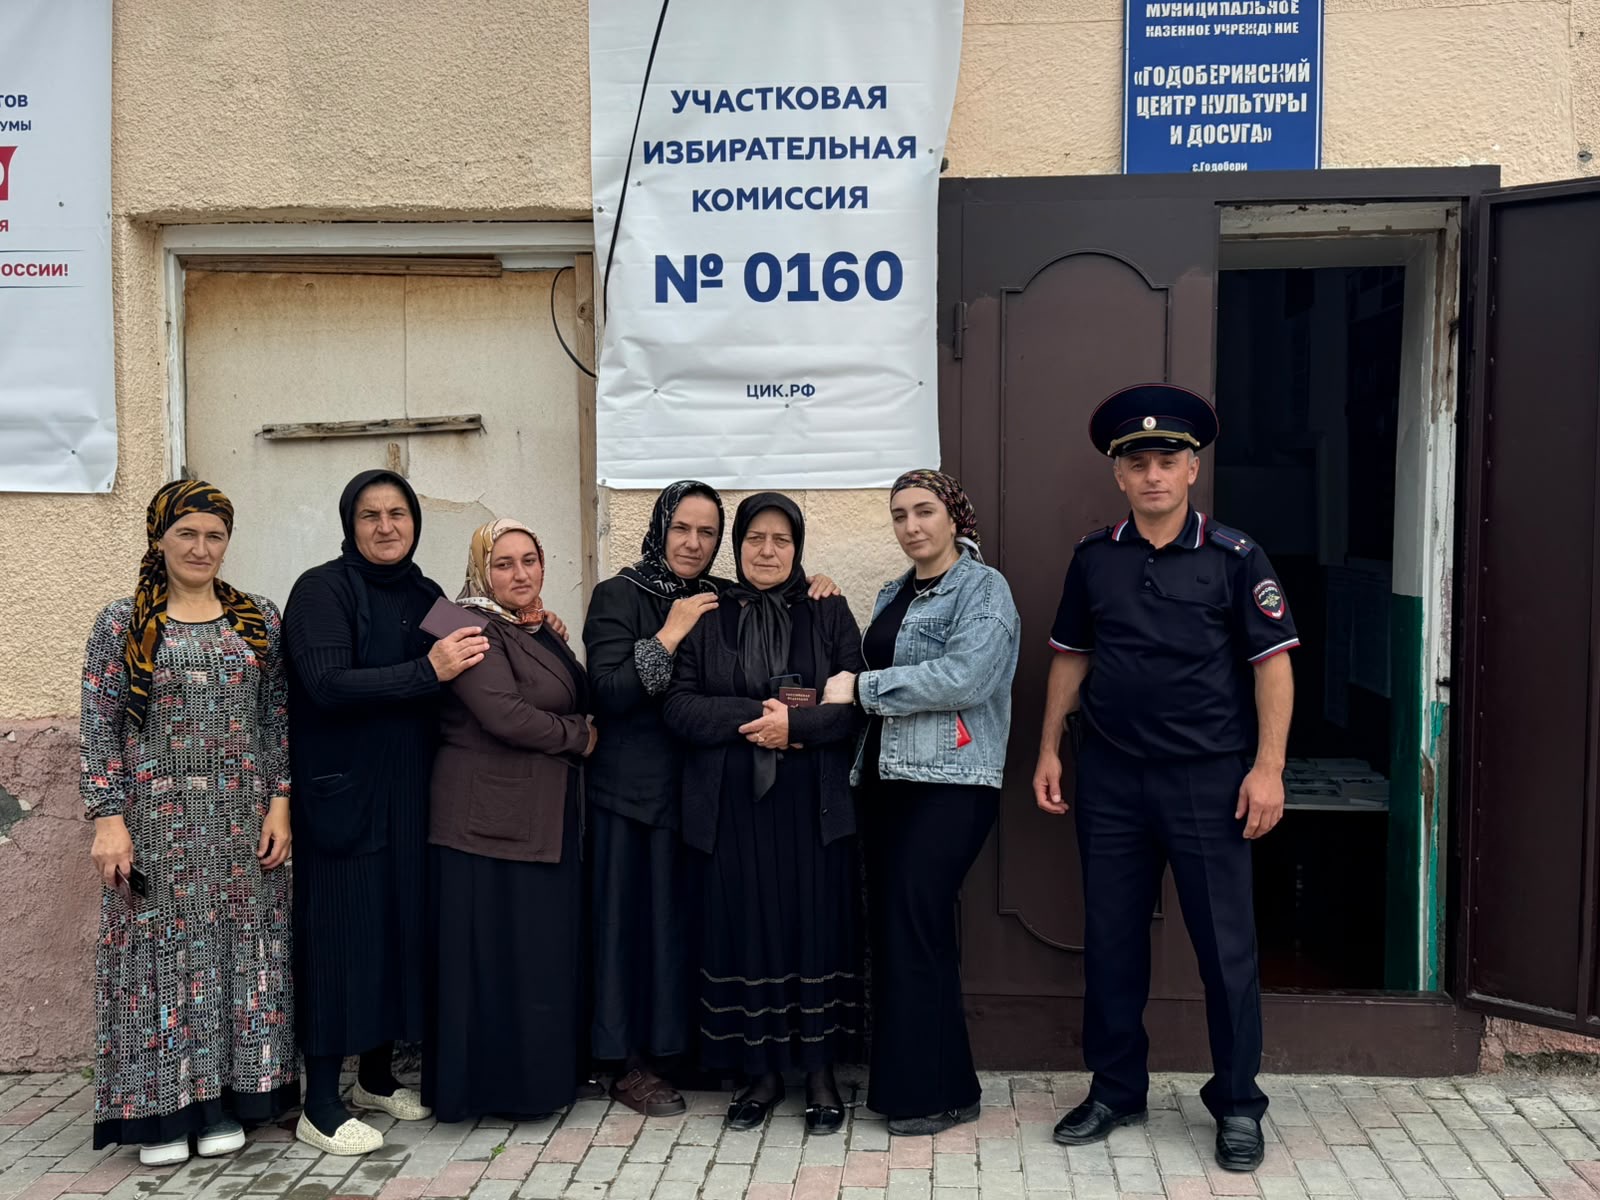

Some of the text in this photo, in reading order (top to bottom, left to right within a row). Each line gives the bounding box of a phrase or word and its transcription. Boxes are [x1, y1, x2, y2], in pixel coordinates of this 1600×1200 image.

[1147, 0, 1299, 18] МУНИЦИПАЛЬНОЕ
[1146, 25, 1210, 37] КАЗЕННОЕ
[1134, 58, 1309, 88] «ГОДОБЕРИНСКИЙ
[671, 86, 886, 113] УЧАСТКОВАЯ
[1137, 93, 1306, 119] ЦЕНТР КУЛЬТУРЫ
[1171, 124, 1271, 147] И ДОСУГА»
[644, 136, 916, 164] ИЗБИРАТЕЛЬНАЯ
[1193, 162, 1247, 172] с.Годобери
[693, 186, 867, 212] КОМИССИЯ
[655, 251, 903, 303] № 0160
[747, 384, 815, 399] ЦИК.РФ
